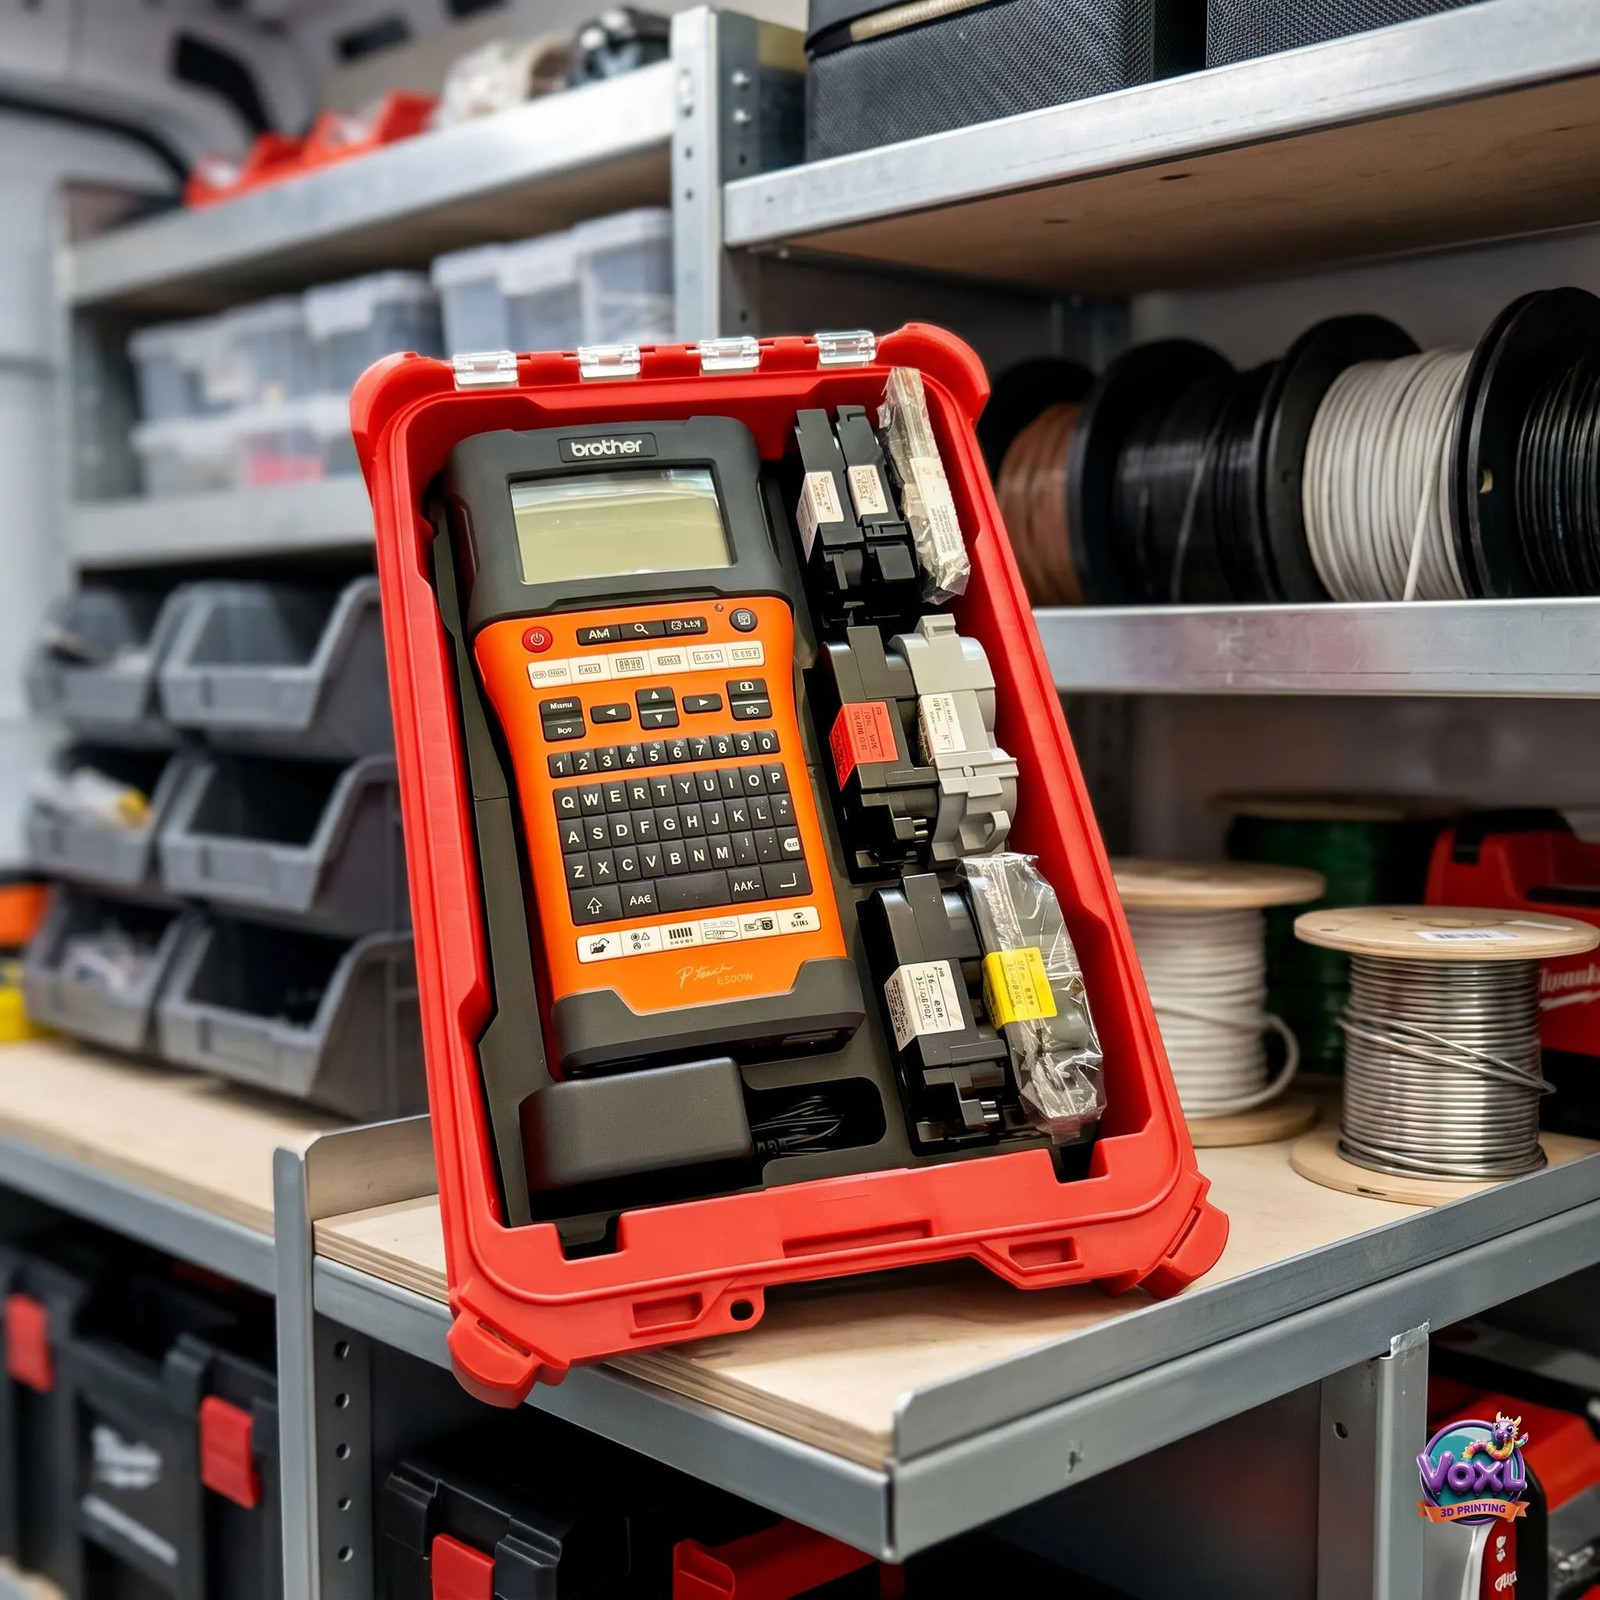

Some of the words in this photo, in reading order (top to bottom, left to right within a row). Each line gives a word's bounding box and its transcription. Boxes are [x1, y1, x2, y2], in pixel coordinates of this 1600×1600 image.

[570, 439, 643, 457] brother
[556, 760, 564, 773] 1
[578, 758, 588, 771] 2
[602, 754, 612, 767] 3
[625, 752, 636, 764] 4
[649, 749, 659, 762] 5
[673, 746, 682, 759] 6
[695, 744, 704, 756] 7
[718, 741, 728, 754] 8
[740, 739, 750, 751] 9
[762, 737, 771, 750] 0
[561, 796, 575, 809] Q
[582, 792, 599, 806] W
[609, 789, 622, 803] E
[633, 787, 646, 800] R
[656, 784, 667, 797] T
[679, 781, 691, 794] Y
[703, 778, 715, 792] U
[728, 777, 734, 789] I
[748, 774, 760, 787] O
[770, 772, 781, 784] P
[568, 830, 580, 844] A
[592, 827, 604, 840] S
[615, 824, 628, 837] D
[639, 820, 650, 834] F
[663, 818, 676, 831] G
[686, 815, 699, 828] H
[711, 812, 720, 825] J
[732, 809, 745, 823] K
[756, 807, 767, 820] L
[573, 865, 585, 879] Z
[597, 861, 610, 875] X
[622, 858, 634, 871] C
[645, 854, 657, 868] V
[669, 852, 682, 865] B
[693, 848, 705, 862] N
[715, 846, 729, 860] M
